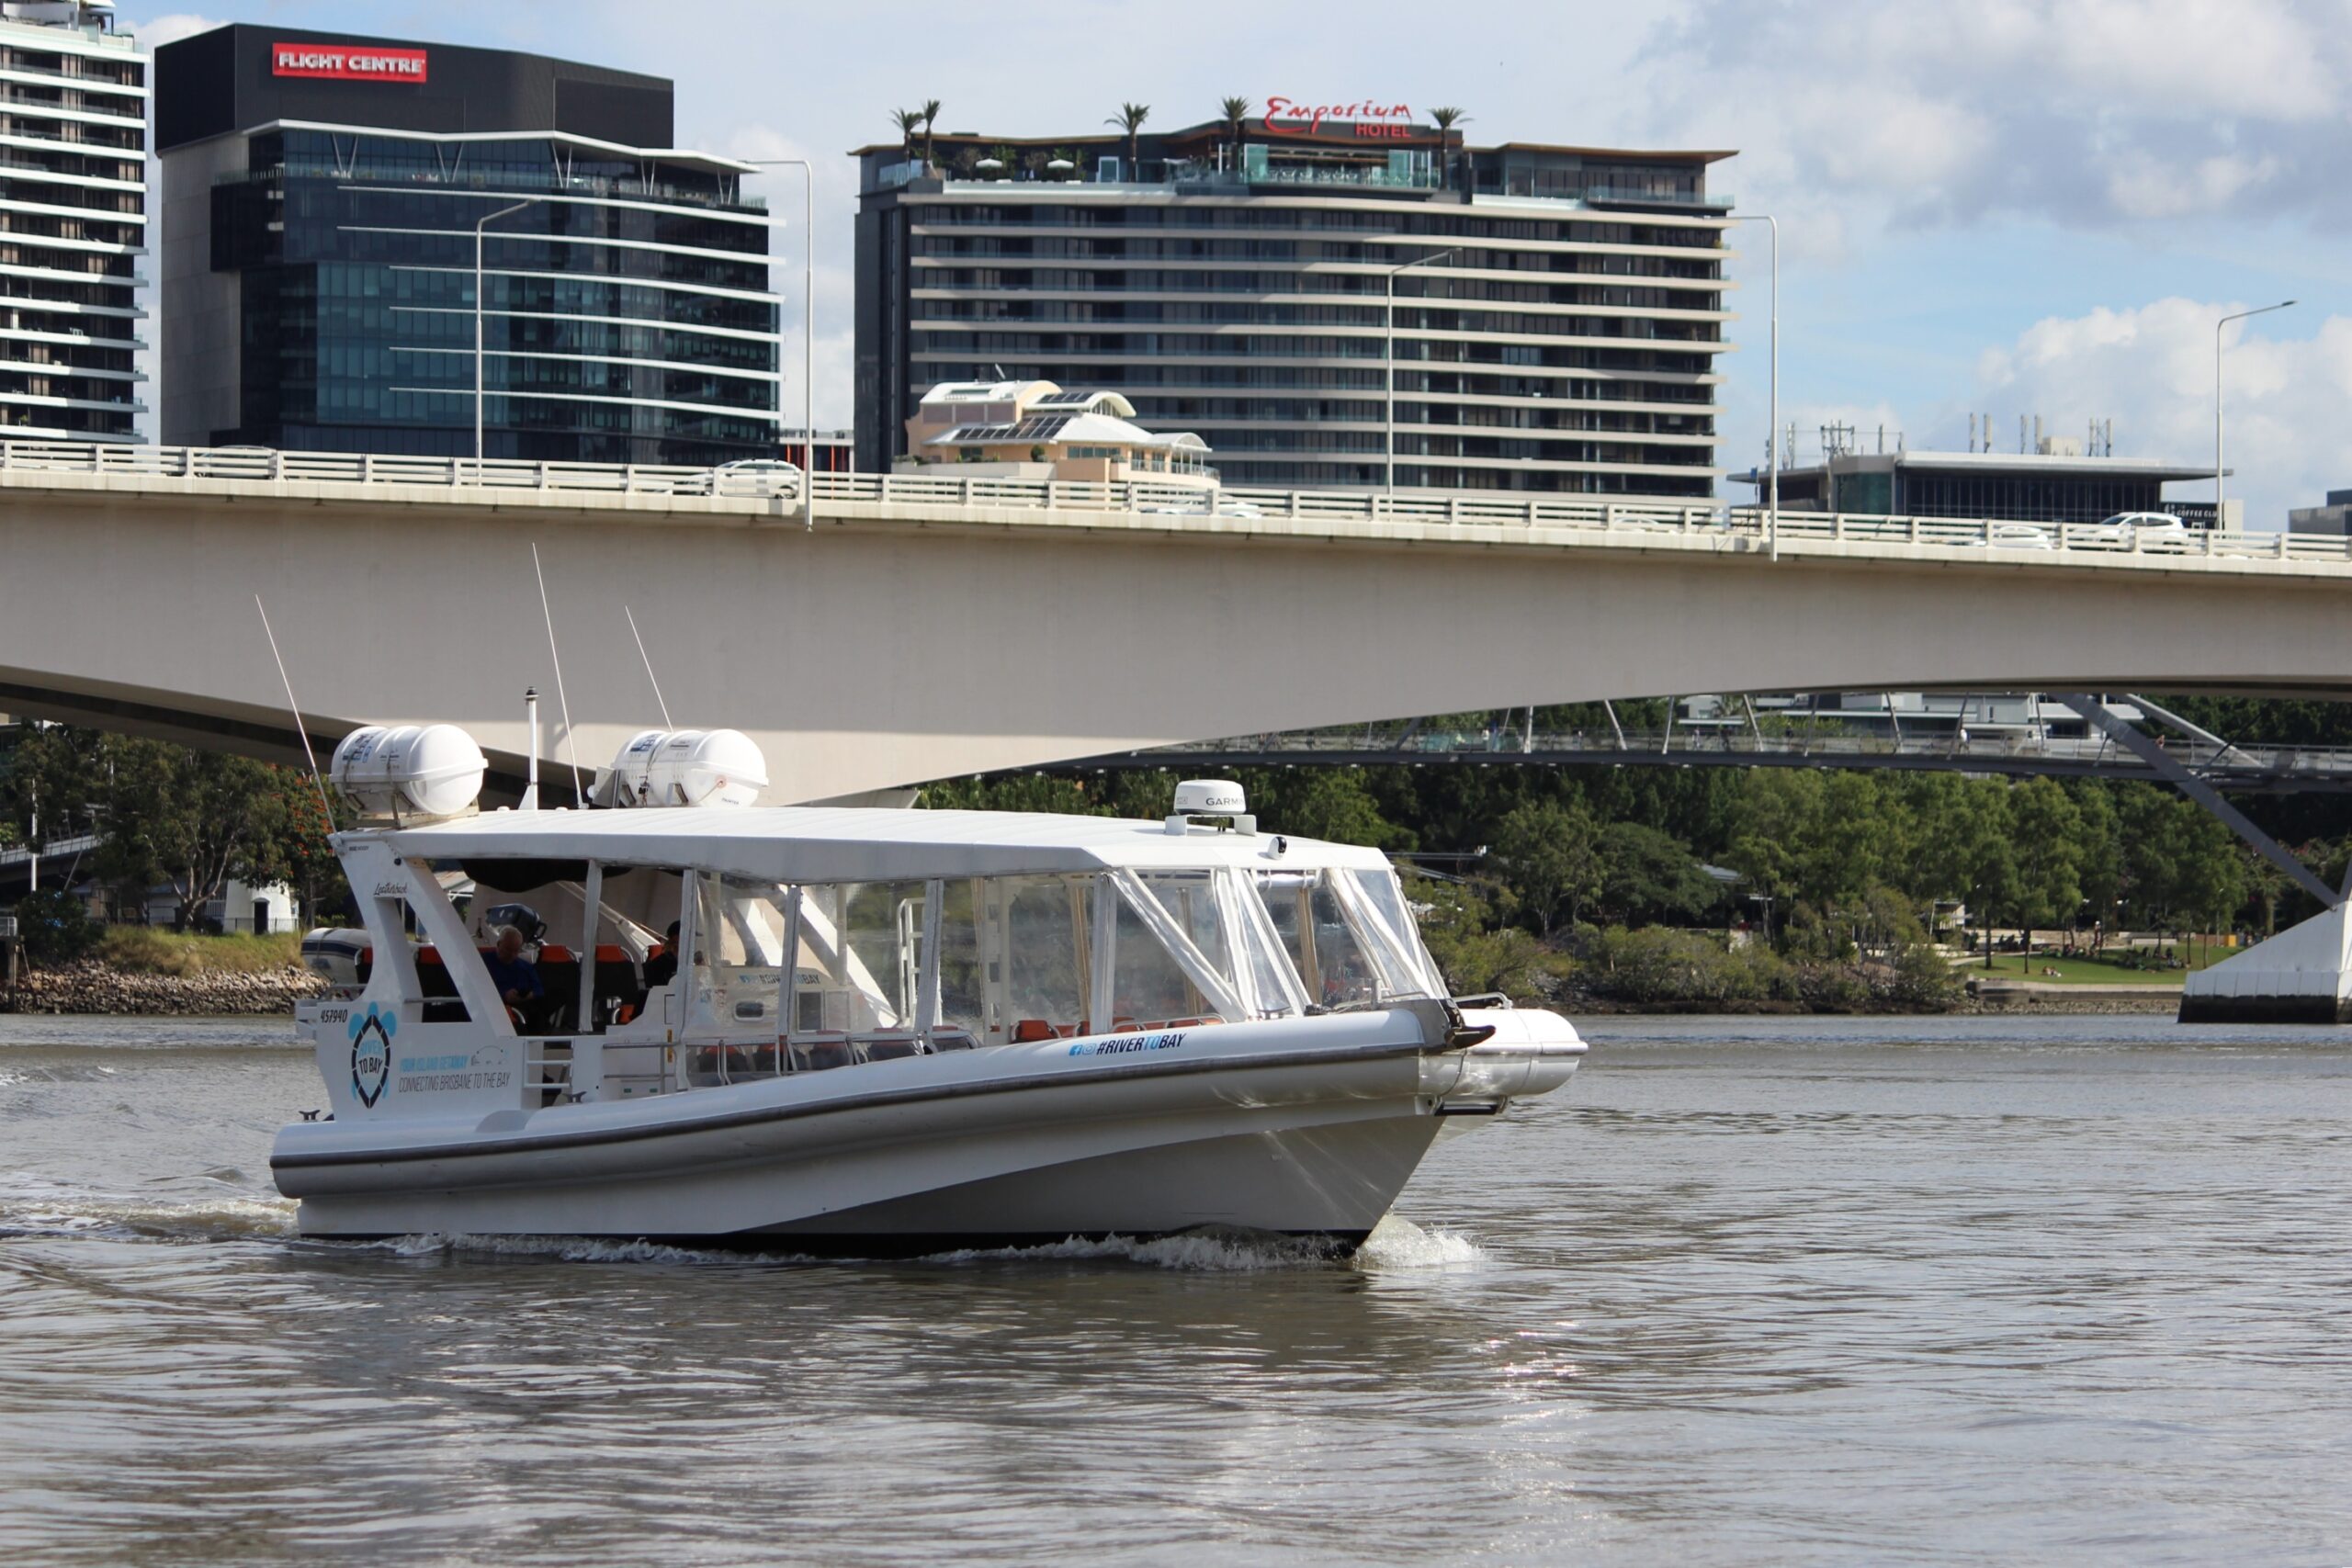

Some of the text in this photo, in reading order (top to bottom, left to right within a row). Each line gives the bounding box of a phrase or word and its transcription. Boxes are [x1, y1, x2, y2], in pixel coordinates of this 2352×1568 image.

[278, 51, 422, 73] FLIGHT CENTRE
[1264, 96, 1412, 134] Emporium
[1355, 123, 1411, 138] HOTEL
[2177, 509, 2202, 518] COFFEE
[320, 1009, 348, 1023] 457940
[1096, 1033, 1186, 1055] #RIVERTOBAY
[358, 1056, 383, 1076] TO BAY
[399, 1071, 512, 1093] CONNECTING BRISBANE TO THE BAY
